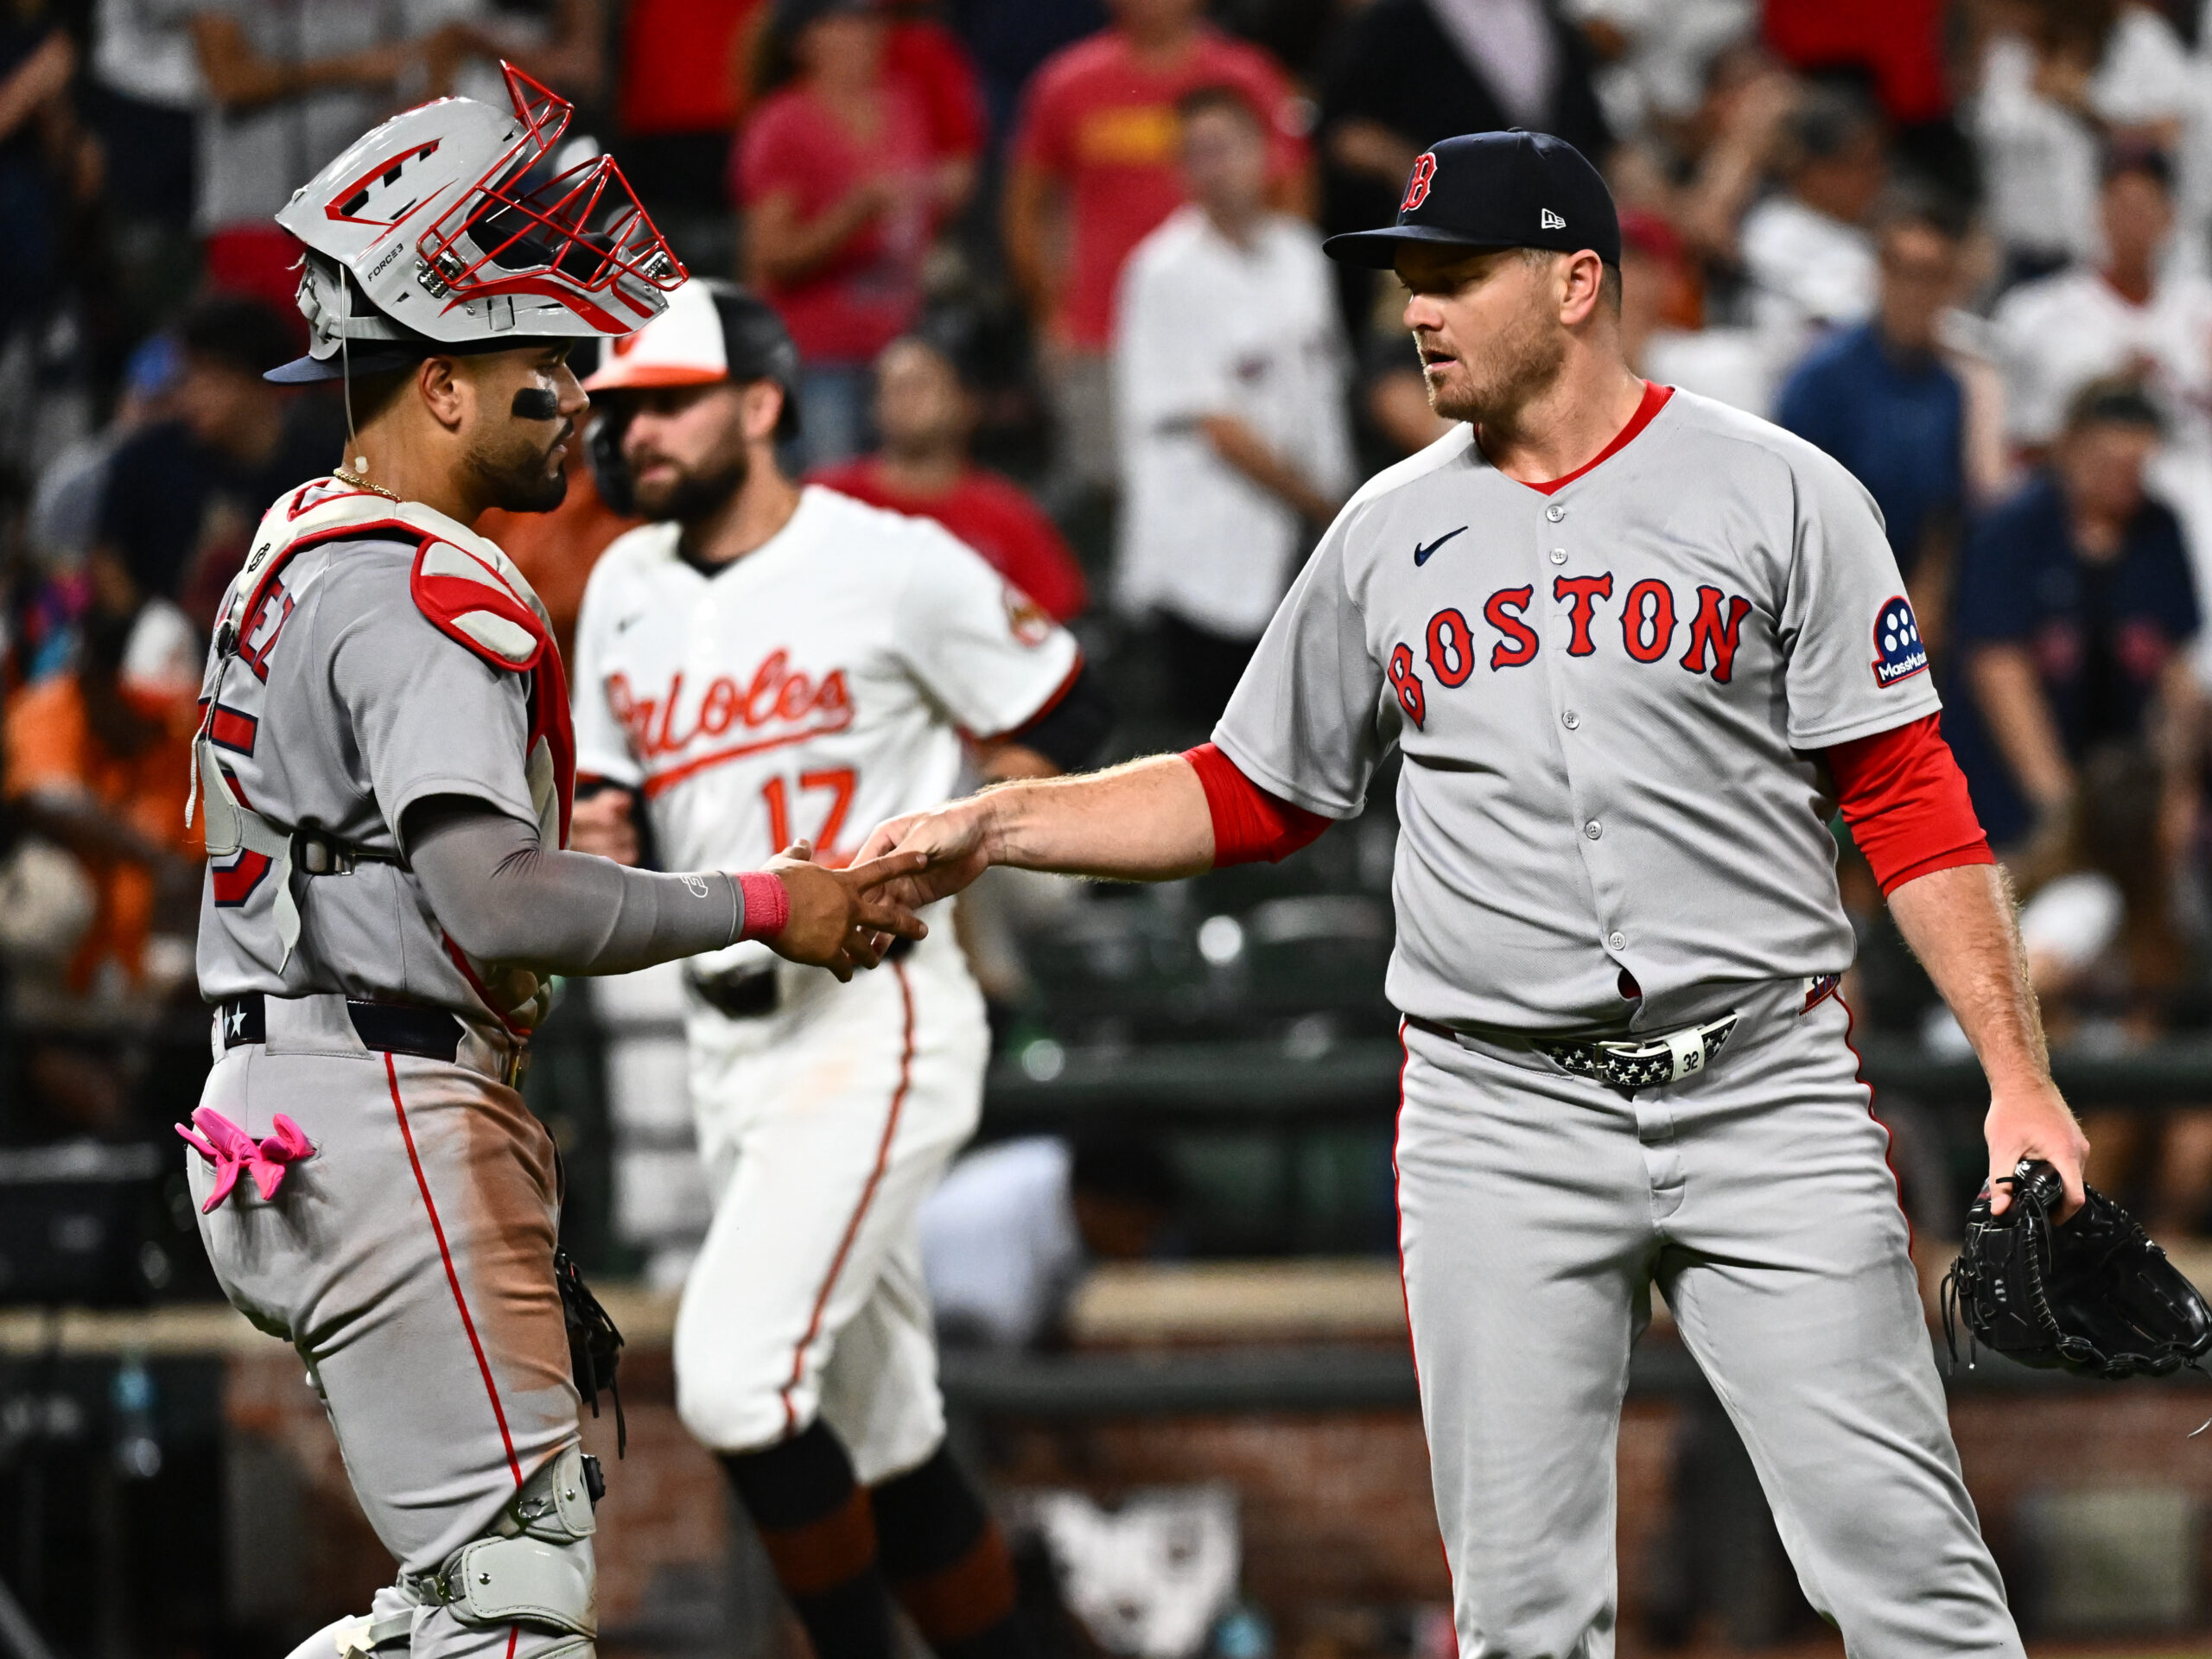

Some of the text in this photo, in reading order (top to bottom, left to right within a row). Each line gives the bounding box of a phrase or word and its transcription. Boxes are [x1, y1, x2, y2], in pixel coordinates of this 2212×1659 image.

[1401, 151, 1438, 213] B
[1387, 570, 1753, 733] BOSTON
[760, 764, 858, 858] 17
[1682, 1051, 1700, 1073] 32
